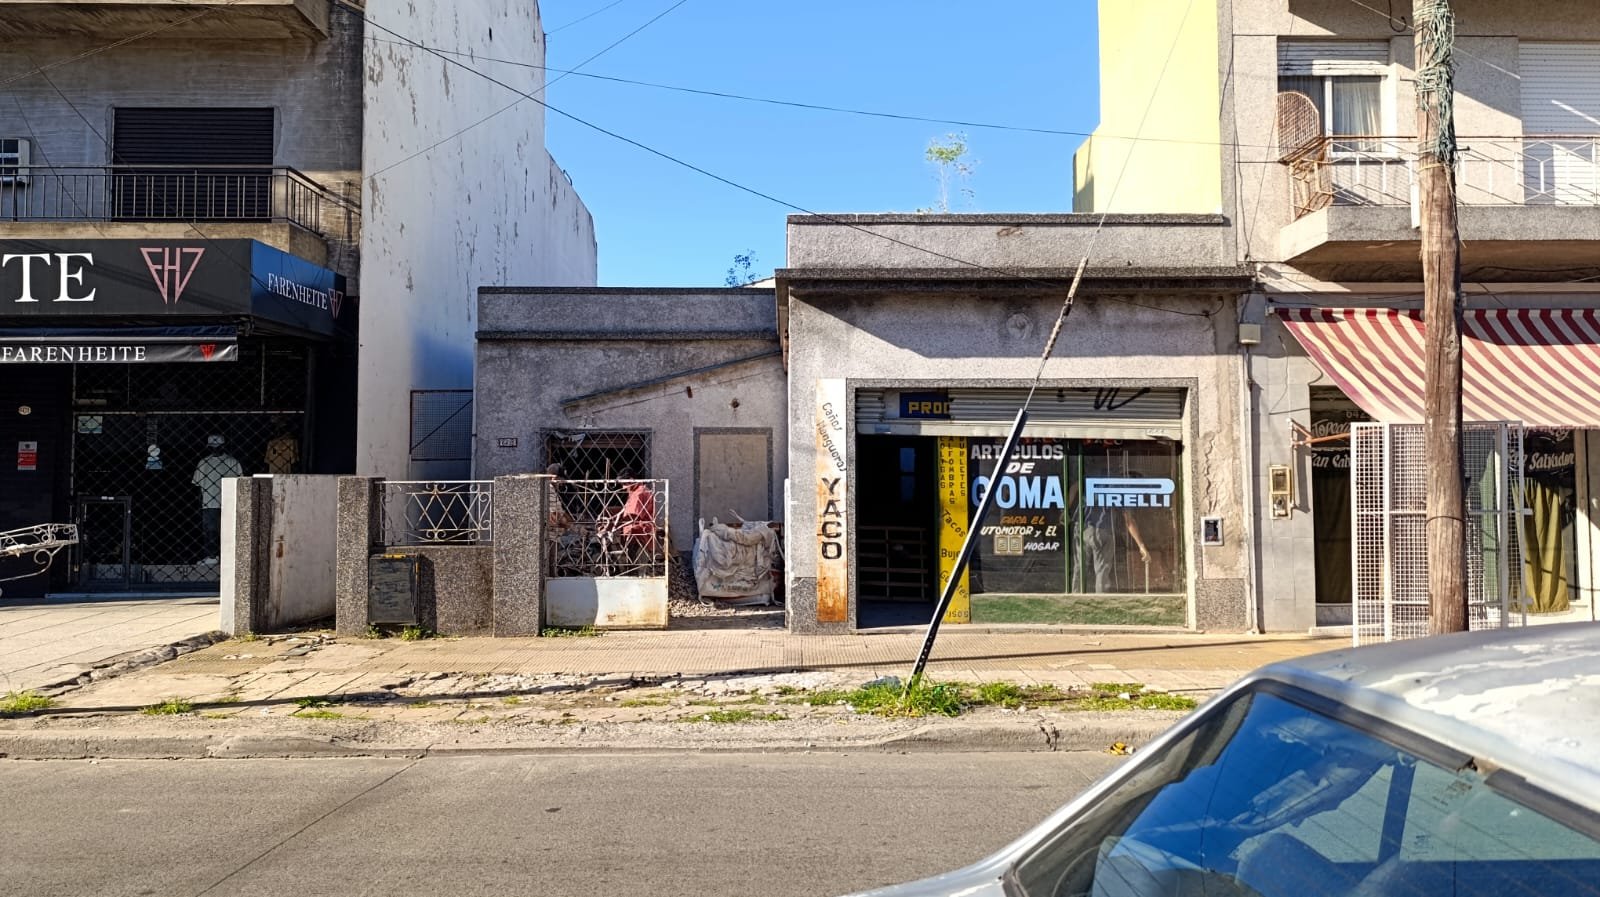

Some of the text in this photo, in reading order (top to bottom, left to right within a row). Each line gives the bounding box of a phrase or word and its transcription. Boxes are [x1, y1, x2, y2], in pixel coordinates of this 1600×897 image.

[267, 272, 328, 310] FARENHEITE
[1, 346, 147, 362] FARENHEITE
[971, 444, 1064, 460] ARTCULOS
[1005, 462, 1036, 474] DE
[1085, 478, 1175, 507] PIRELLI
[821, 477, 842, 560] YACO
[942, 509, 966, 538] Tacos
[1031, 515, 1046, 525] EL
[980, 526, 1034, 536] UTOMOTOR
[1045, 525, 1058, 537] EL
[1024, 542, 1060, 551] HOGAR
